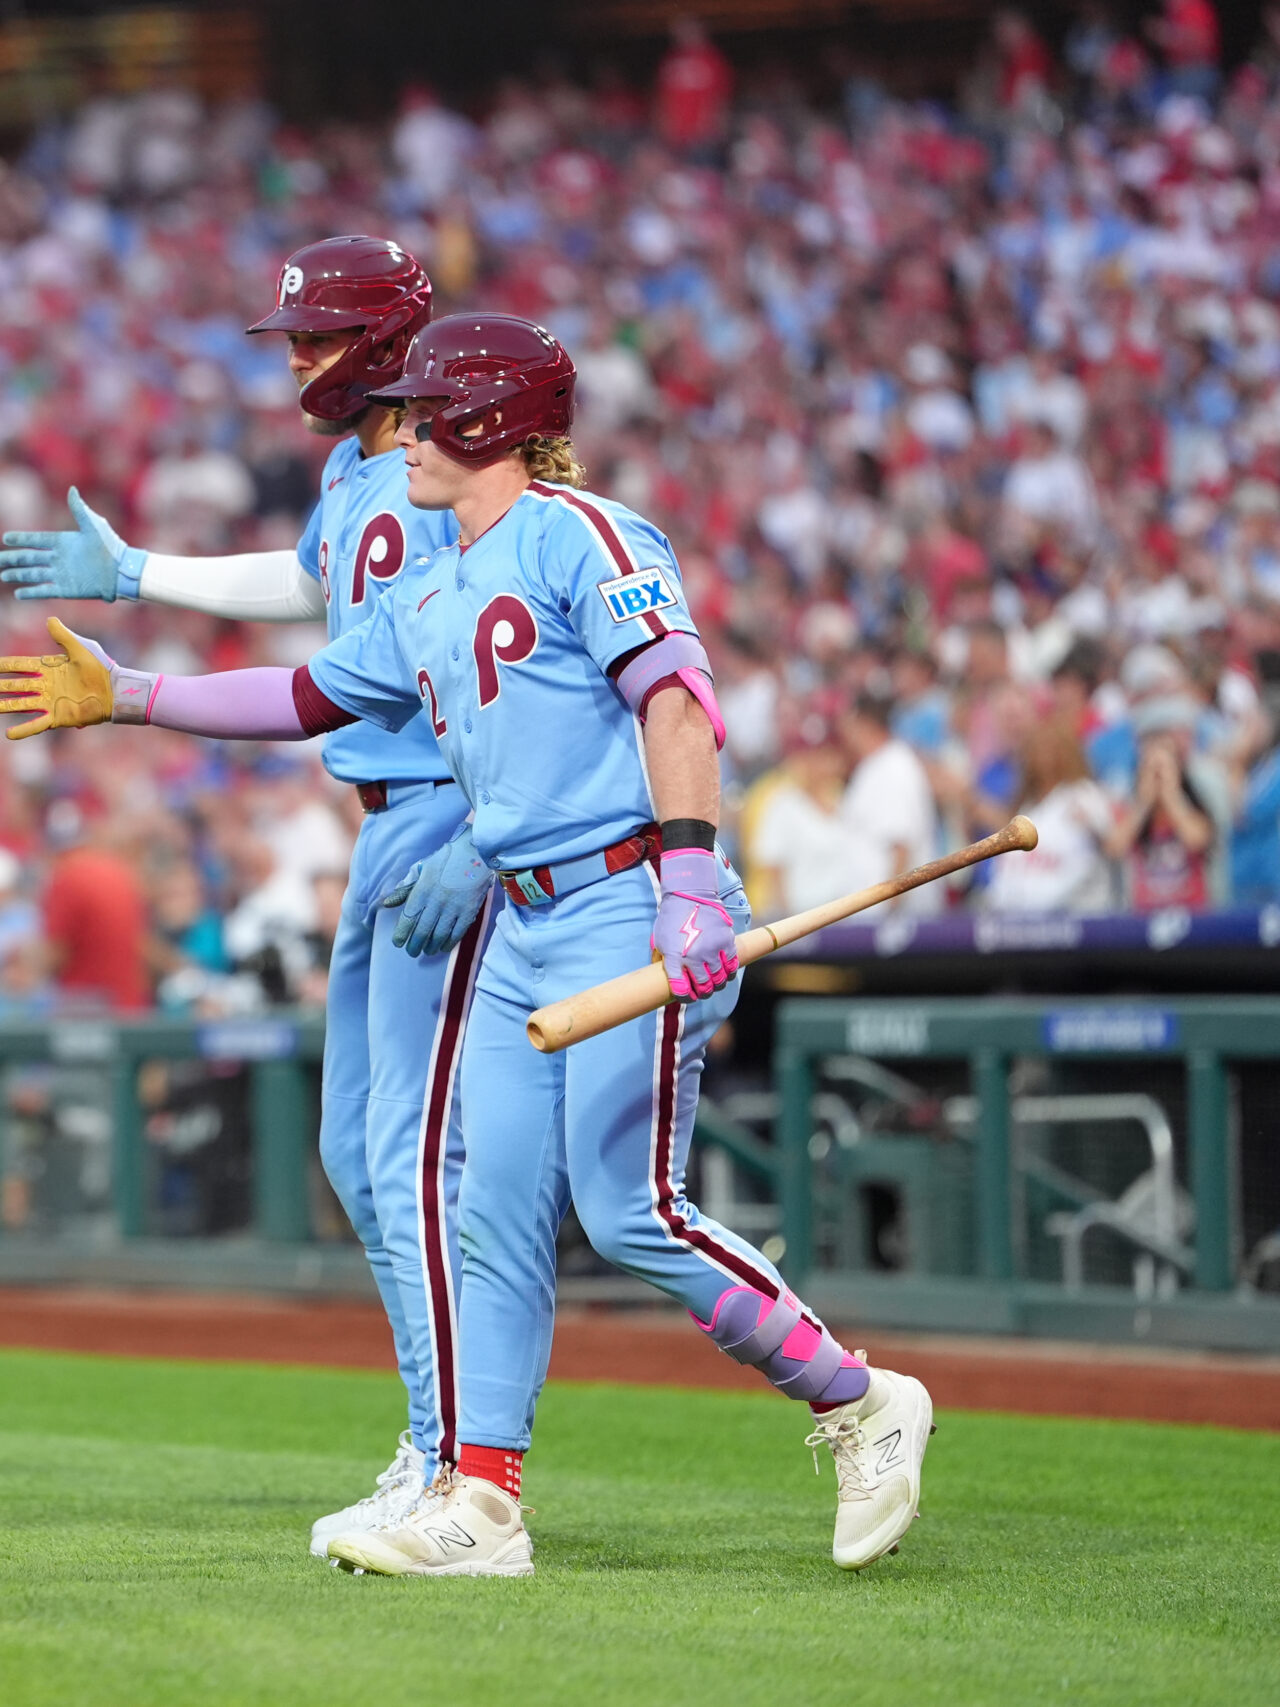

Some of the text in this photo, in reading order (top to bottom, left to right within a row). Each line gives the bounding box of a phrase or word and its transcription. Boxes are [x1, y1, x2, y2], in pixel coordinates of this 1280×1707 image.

[280, 266, 304, 306] P
[350, 510, 406, 607] P
[608, 580, 671, 618] IBX
[472, 592, 539, 711] P
[521, 882, 542, 900] 12
